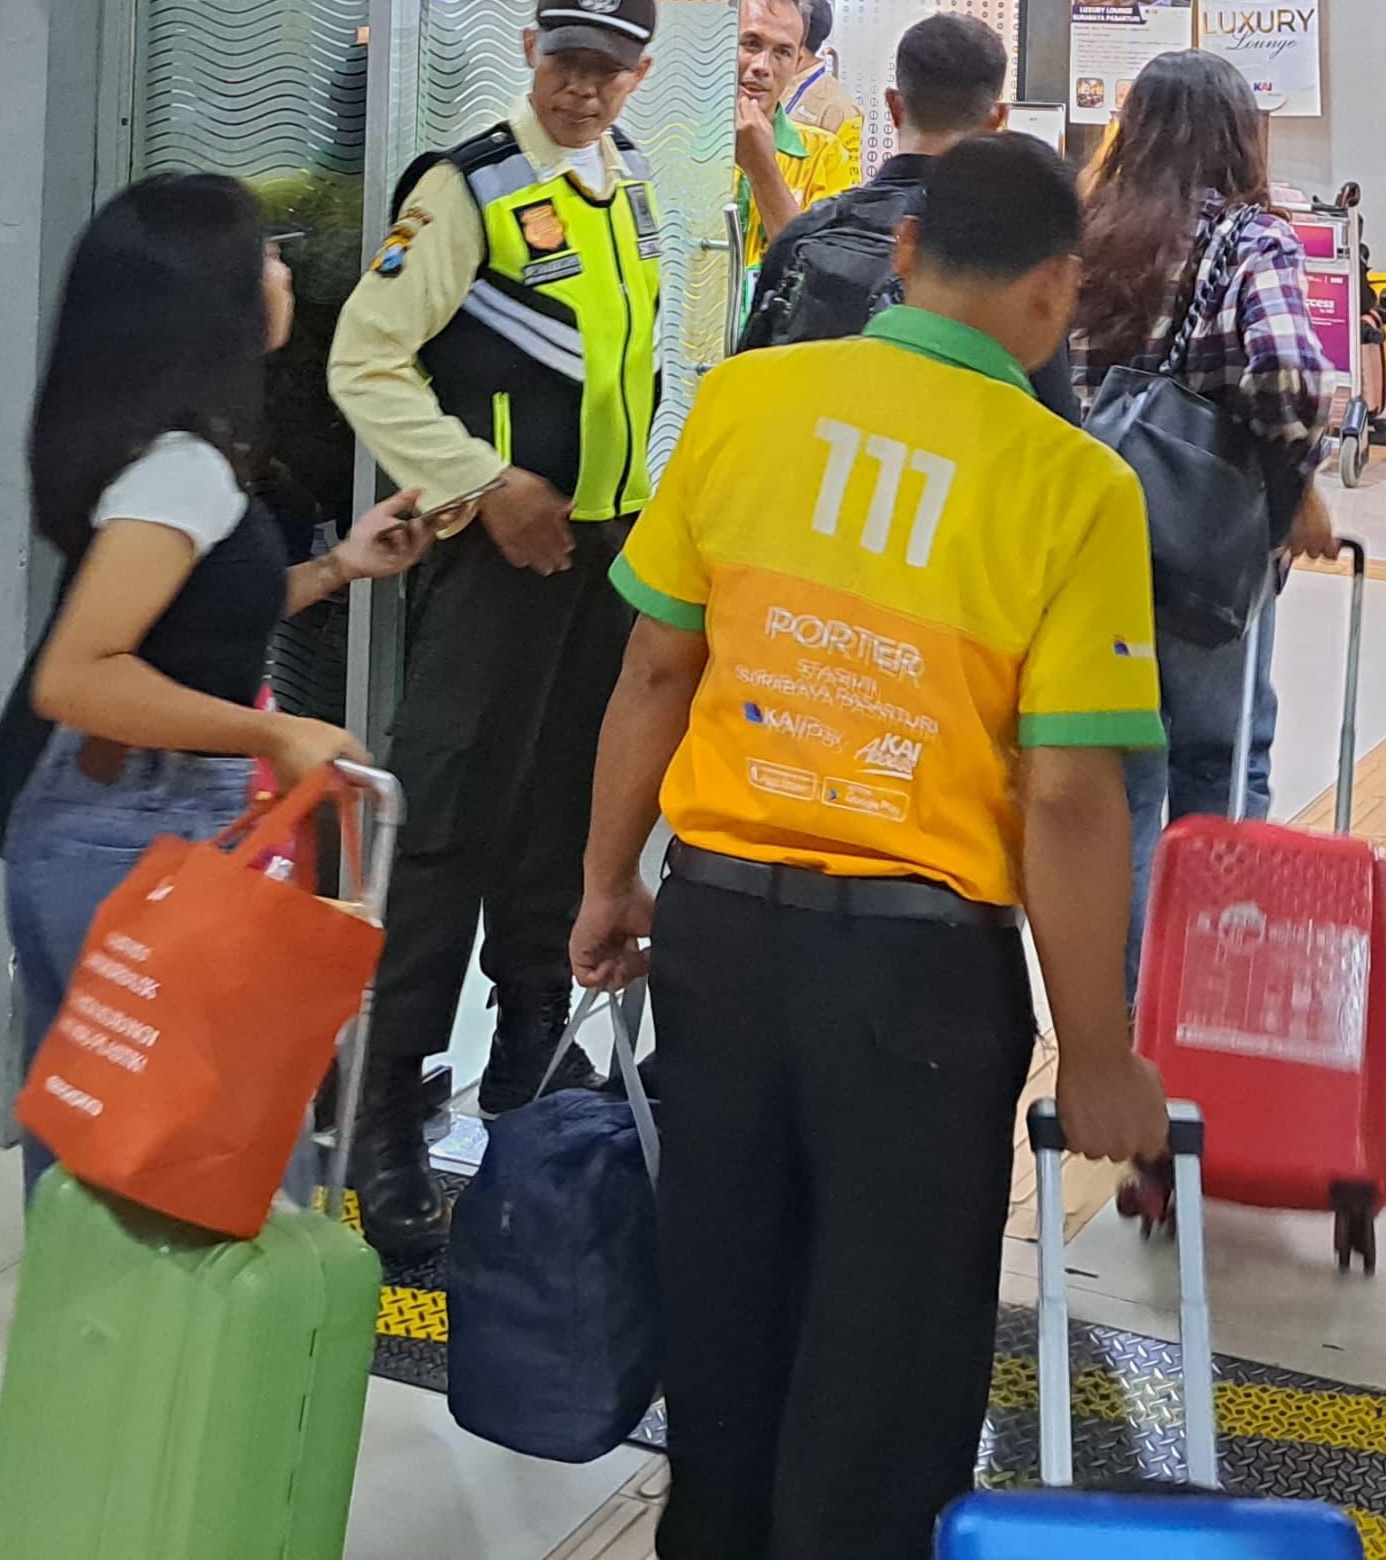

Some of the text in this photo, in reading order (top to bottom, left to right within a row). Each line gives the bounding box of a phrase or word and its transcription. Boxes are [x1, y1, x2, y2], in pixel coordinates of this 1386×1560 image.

[1203, 8, 1315, 35] LUXURY
[1225, 31, 1298, 60] Lounge
[811, 417, 957, 568] 111
[765, 606, 925, 685] PORTER
